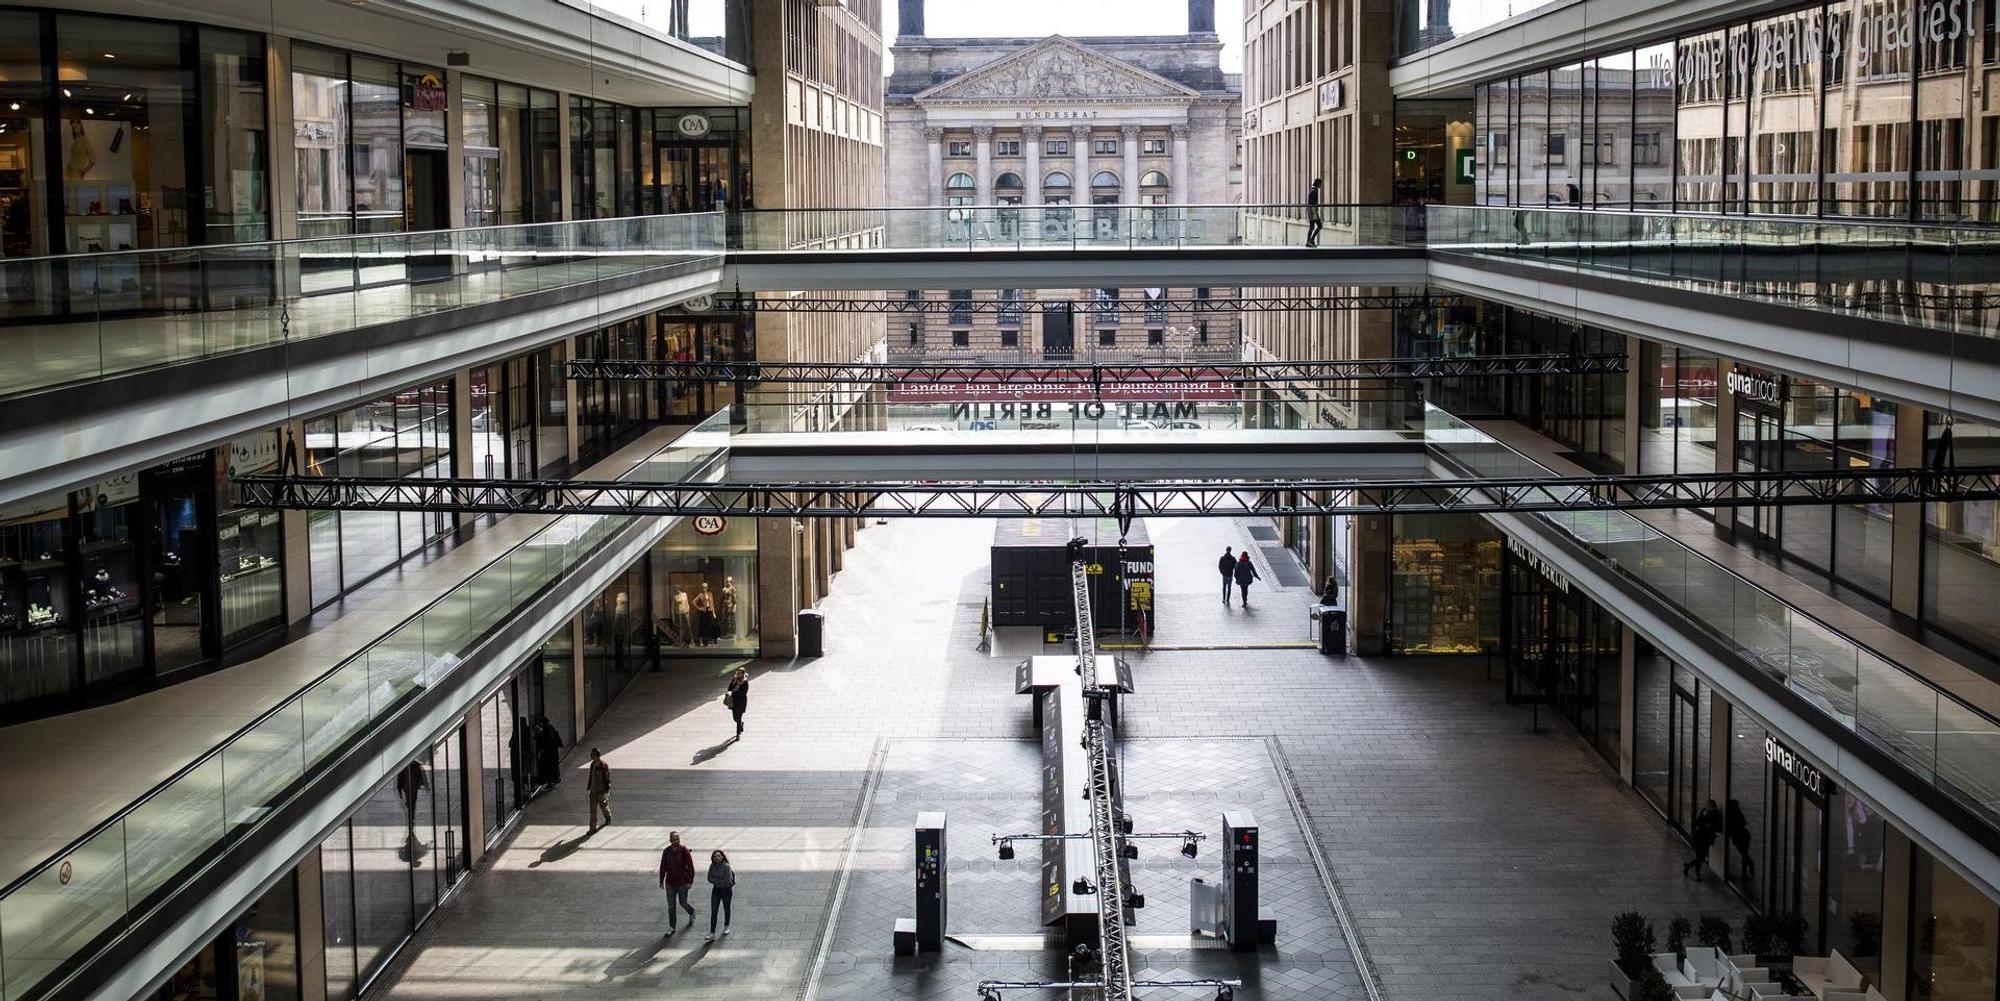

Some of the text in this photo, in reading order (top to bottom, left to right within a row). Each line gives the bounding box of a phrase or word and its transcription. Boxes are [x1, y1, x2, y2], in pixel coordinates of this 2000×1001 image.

[1650, 45, 1721, 88] Wecome
[1016, 111, 1098, 119] BUNDESRAT
[682, 118, 705, 131] C&A
[698, 517, 720, 529] C&A
[1127, 561, 1153, 573] FUND
[1507, 536, 1569, 594] MALL OF BERLIN
